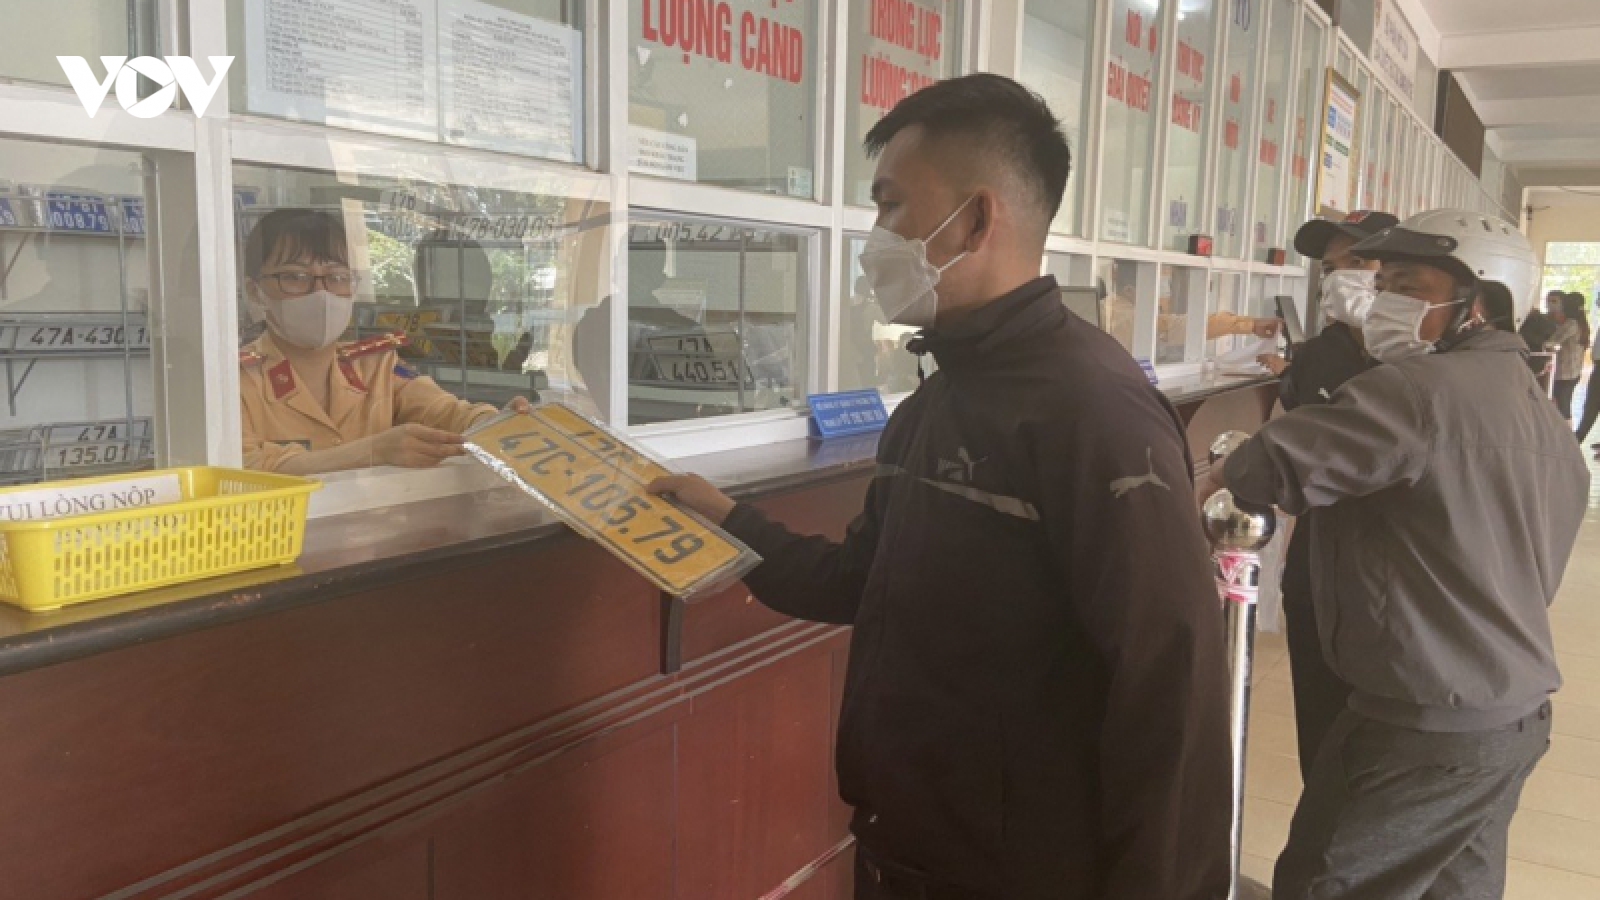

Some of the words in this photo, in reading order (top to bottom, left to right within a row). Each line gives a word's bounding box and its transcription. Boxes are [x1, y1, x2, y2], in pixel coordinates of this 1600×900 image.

[740, 10, 803, 84] CAND
[58, 443, 131, 466] 135.01
[41, 494, 105, 518] LÒNG
